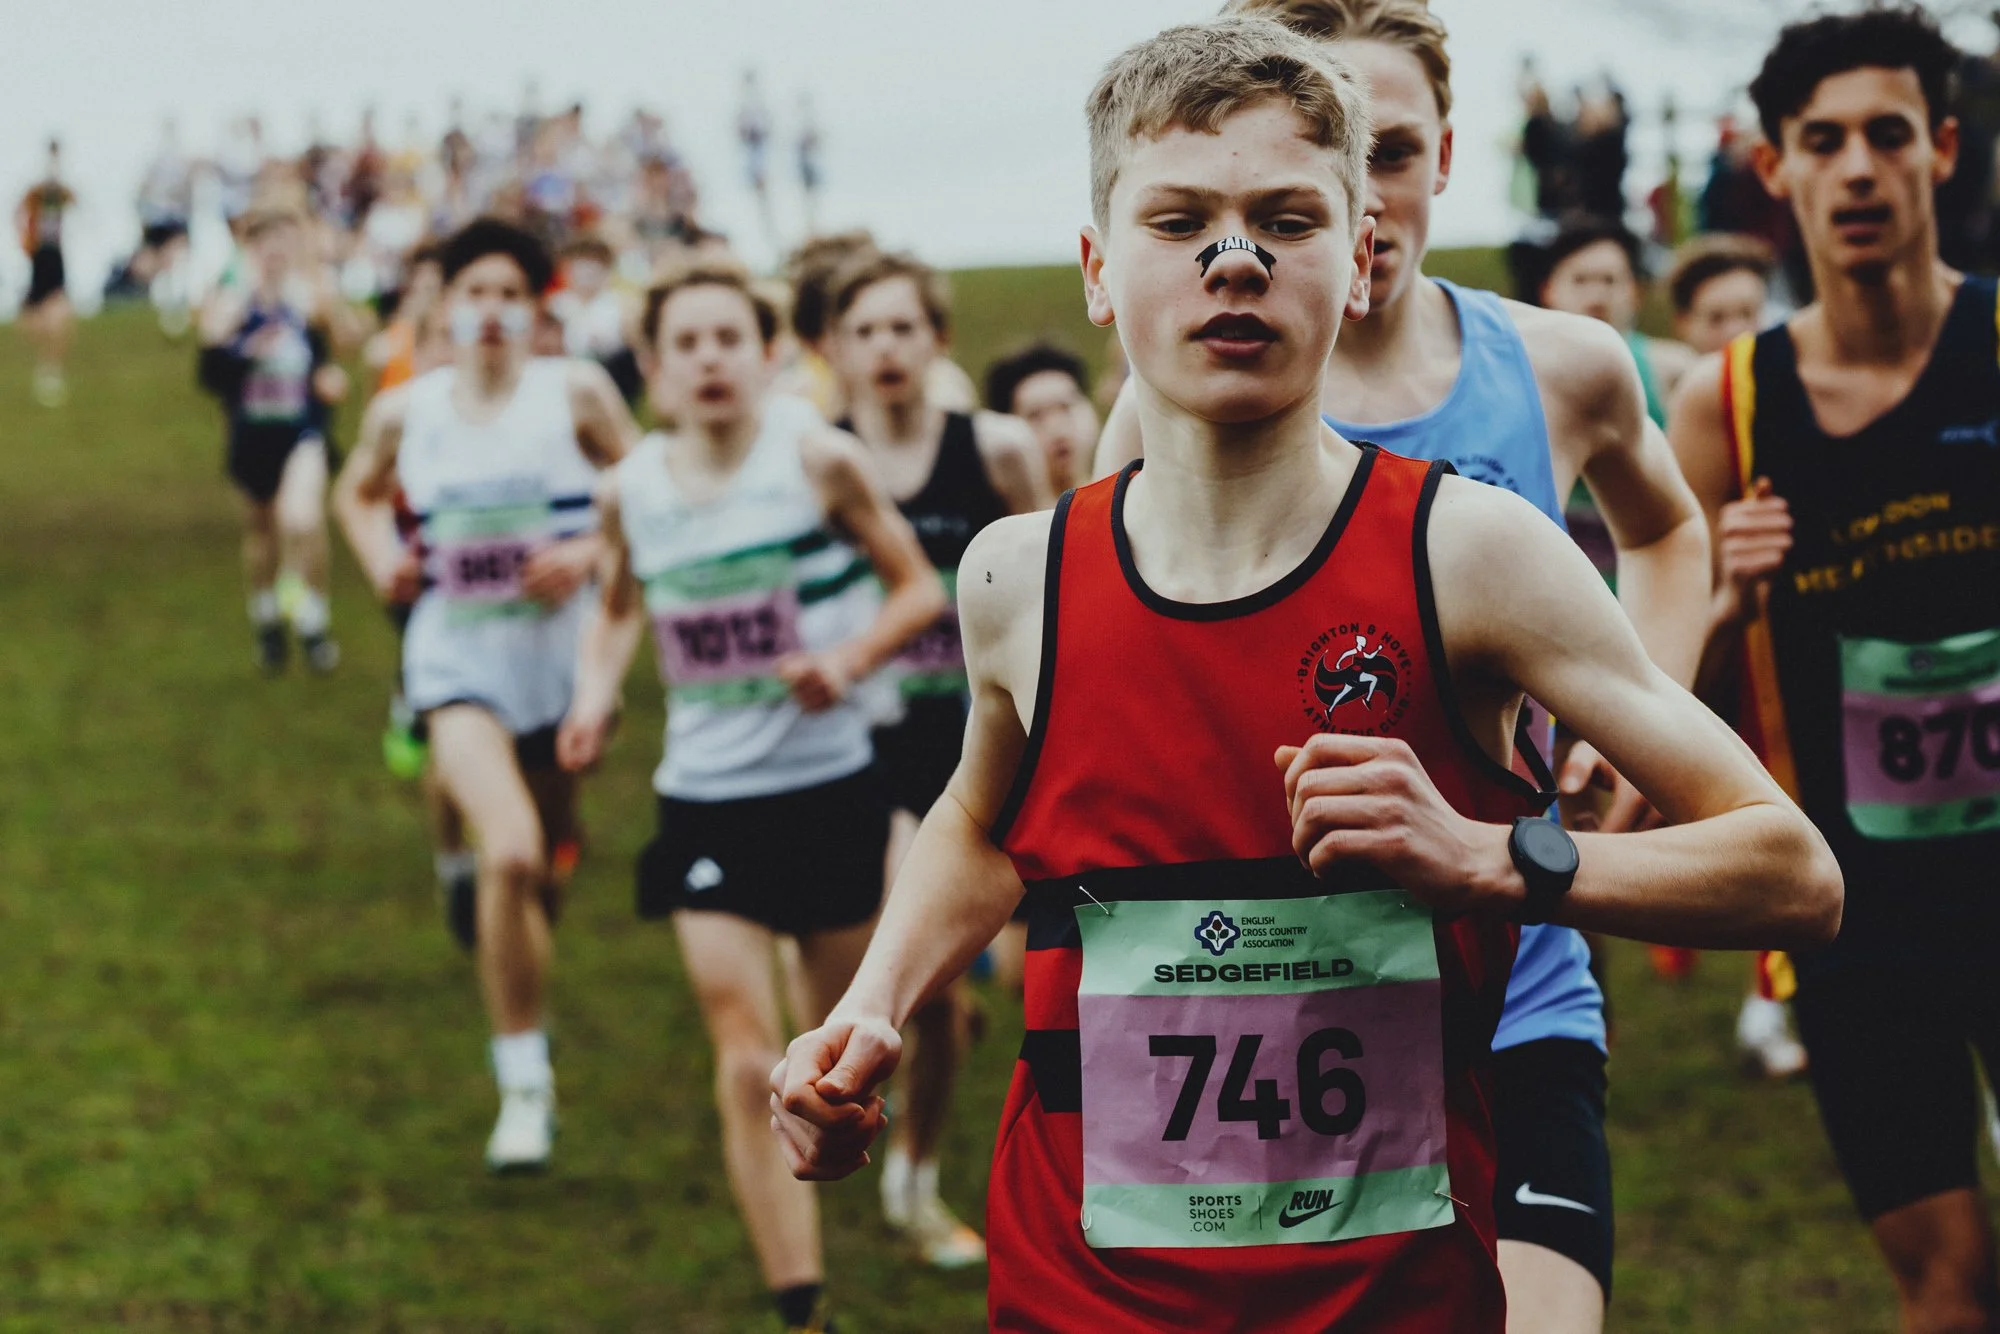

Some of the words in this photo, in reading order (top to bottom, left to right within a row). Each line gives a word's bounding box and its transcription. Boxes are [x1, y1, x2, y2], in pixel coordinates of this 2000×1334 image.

[1217, 236, 1257, 253] FAITH
[1794, 525, 2000, 591] HEHSIDE
[1297, 622, 1360, 677] BRIGHTON
[1380, 631, 1412, 670] HOVE
[1878, 707, 2000, 783] 870
[1241, 916, 1275, 925] ENGLISH
[1242, 928, 1268, 936] CROSS
[1269, 926, 1308, 936] COUNTRY
[1242, 938, 1295, 948] ASSOCIATION
[1154, 958, 1355, 983] SEDGEFIELD
[1148, 1027, 1366, 1141] 746
[1188, 1195, 1242, 1206] SPORTS
[1289, 1189, 1334, 1211] RUN
[1189, 1209, 1235, 1219] SHOES
[1189, 1221, 1226, 1232] .COM
